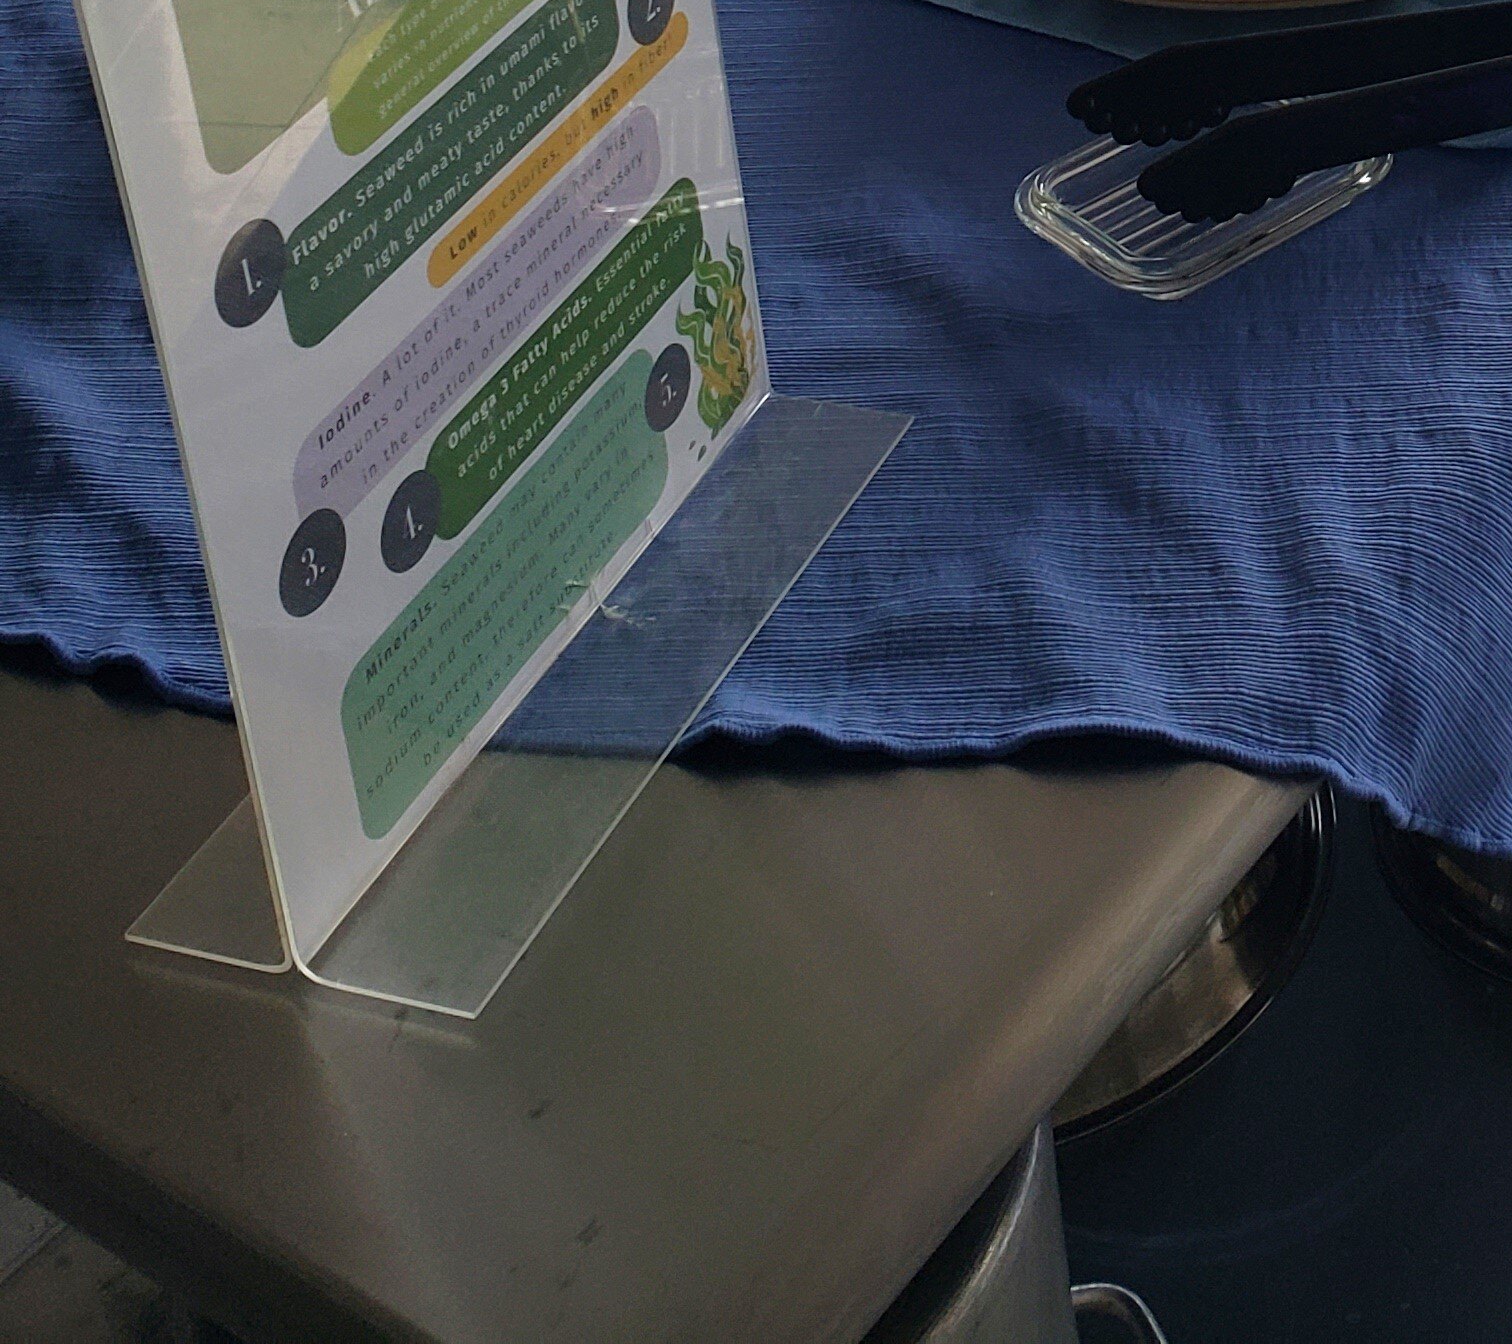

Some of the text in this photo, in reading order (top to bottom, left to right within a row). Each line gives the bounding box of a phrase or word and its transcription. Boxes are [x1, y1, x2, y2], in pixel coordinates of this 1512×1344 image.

[291, 207, 353, 268] Flavor.
[354, 134, 424, 210] Seaweed
[427, 121, 443, 143] is
[447, 86, 477, 126] rich
[479, 73, 495, 96] in
[499, 23, 546, 79] umami
[308, 273, 320, 294] a
[323, 217, 380, 277] savory
[383, 183, 413, 225] and
[417, 141, 464, 192] meaty
[466, 102, 510, 144] taste,
[511, 52, 559, 104] thanks
[561, 36, 577, 57] to
[363, 81, 567, 280] high glutamic acid content.
[448, 225, 479, 262] Low
[589, 82, 619, 122] high
[240, 248, 263, 298] 1.
[317, 389, 376, 452] Iodine.
[381, 366, 391, 387] A
[396, 338, 418, 372] lot
[424, 317, 440, 344] of
[465, 258, 499, 302] Most
[503, 191, 568, 264] seaweeds
[319, 148, 644, 491] amounts of iodine, a trace mineral necessary
[446, 392, 497, 452] Omega
[499, 376, 509, 397] 3
[511, 337, 549, 383] Fatty
[551, 294, 592, 342] Acids.
[595, 221, 652, 294] Essential
[457, 217, 686, 480] acids that can help reduce the risk
[361, 461, 378, 487] in
[382, 429, 409, 464] the
[413, 359, 476, 432] creation
[481, 333, 496, 361] of
[499, 279, 549, 341] thyroid
[487, 277, 670, 483] of heart disease and stroke.
[658, 364, 677, 410] 5.
[299, 537, 326, 591] 3.
[398, 496, 424, 549] 4.
